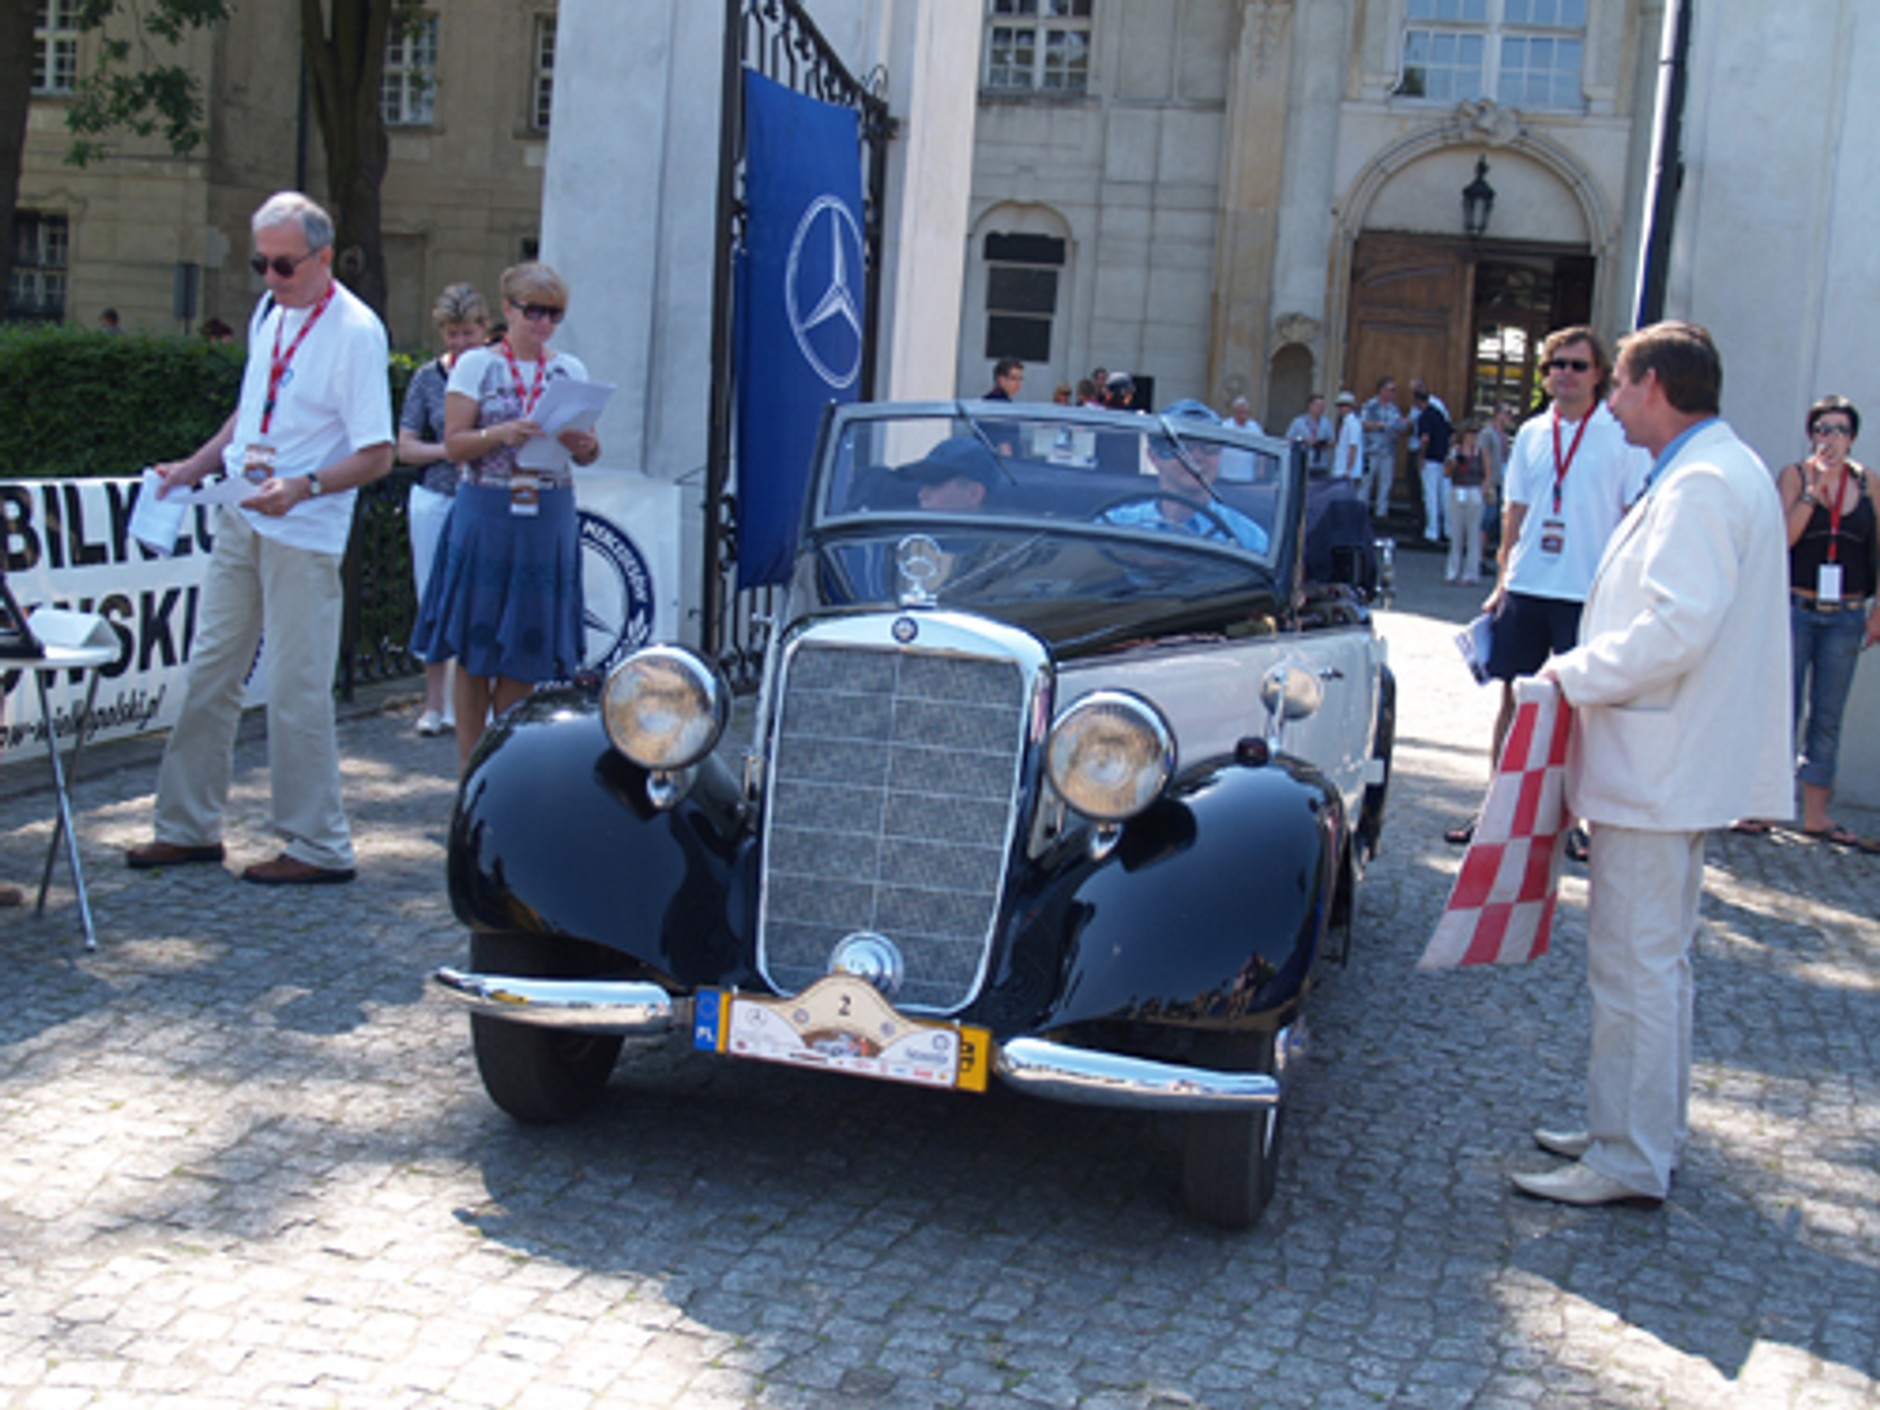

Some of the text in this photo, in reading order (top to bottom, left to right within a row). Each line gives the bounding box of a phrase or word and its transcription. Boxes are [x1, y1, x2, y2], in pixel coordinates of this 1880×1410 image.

[0, 480, 217, 572] BILK
[838, 996, 852, 1016] 2
[696, 1026, 715, 1042] PL
